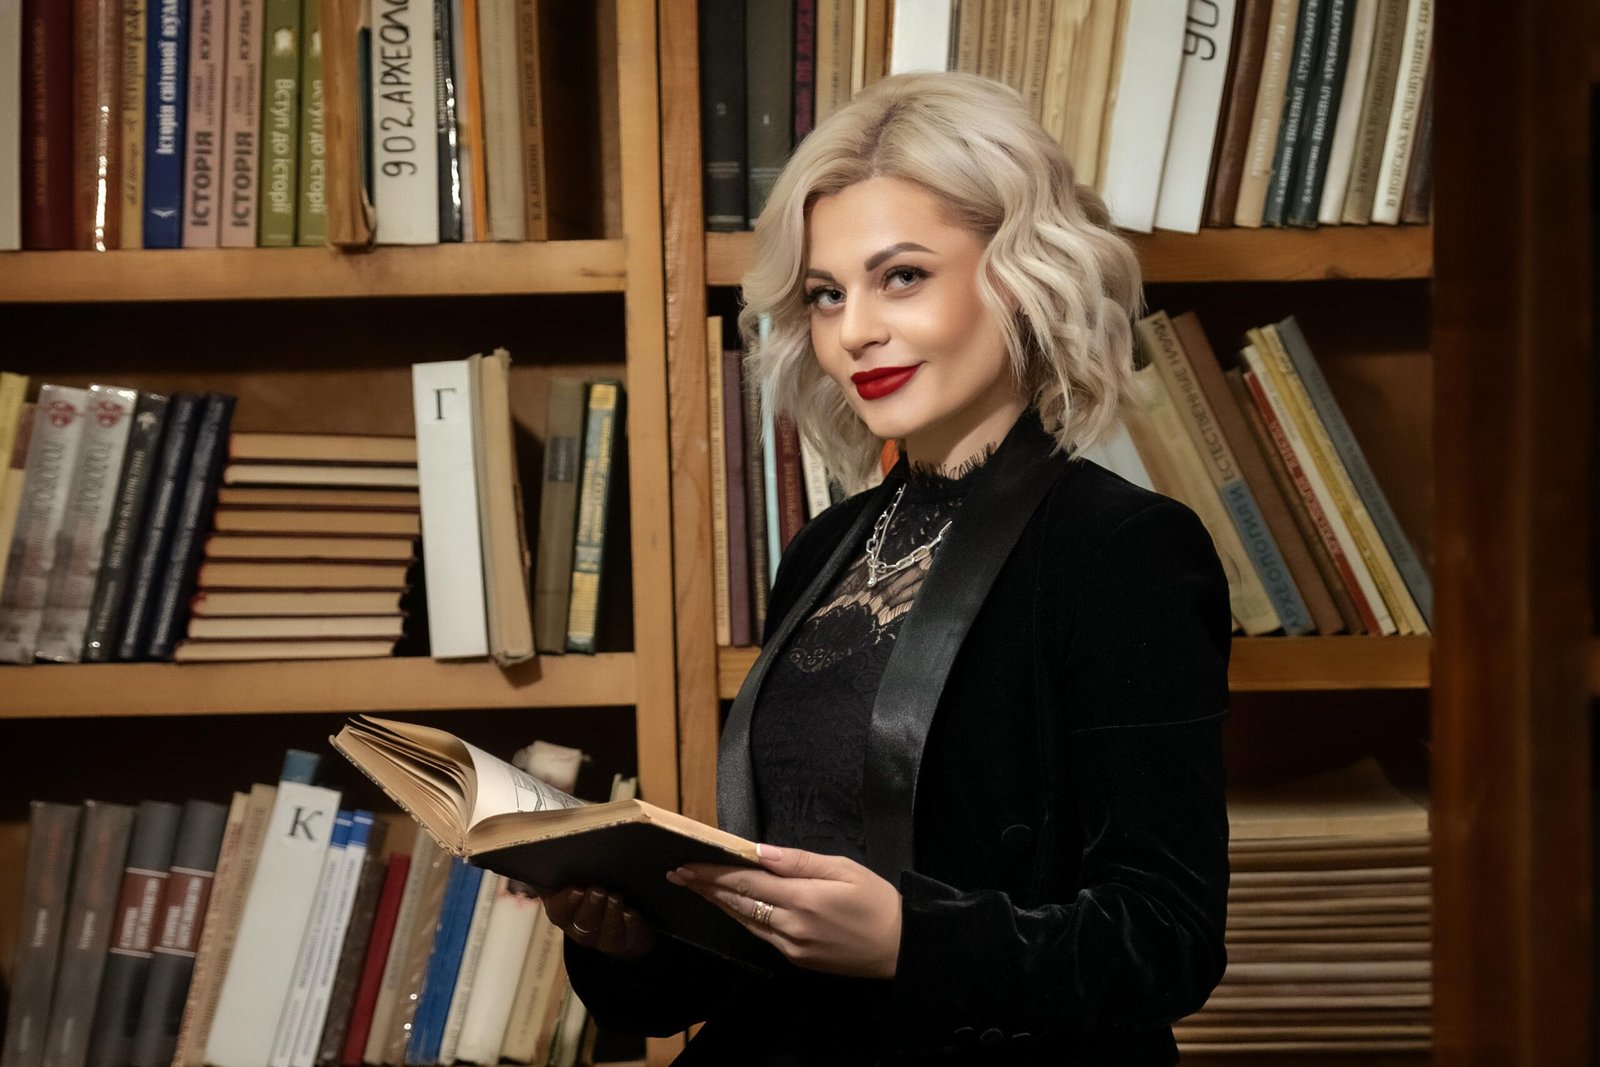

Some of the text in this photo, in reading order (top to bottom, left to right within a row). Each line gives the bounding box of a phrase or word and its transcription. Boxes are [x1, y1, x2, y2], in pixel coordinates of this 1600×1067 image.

[158, 40, 178, 102] світової
[379, 0, 414, 105] АРХЕОЛ
[156, 105, 178, 154] Історія
[268, 79, 295, 214] Вступ до історії
[308, 131, 325, 156] до
[1286, 87, 1305, 142] ПОЛЕВАЯ
[1312, 86, 1332, 142] ПОЛЕВАЯ
[1359, 129, 1377, 184] ПОИСКАХ
[1369, 32, 1394, 125] ИСЧЕЗНУВШИХ
[1388, 131, 1409, 195] ПОИСКАХ
[1400, 29, 1427, 131] ИСЧЕЗНУВШИХ
[192, 131, 213, 226] ІСТОРІЯ
[232, 131, 253, 227] ІСТОРІЯ
[433, 388, 457, 420] Г
[1176, 368, 1237, 482] ЕСТЕСТВЕННЫЕ
[1229, 485, 1245, 498] И
[1236, 503, 1300, 627] АРХЕОЛОГИЯ
[286, 806, 323, 842] К
